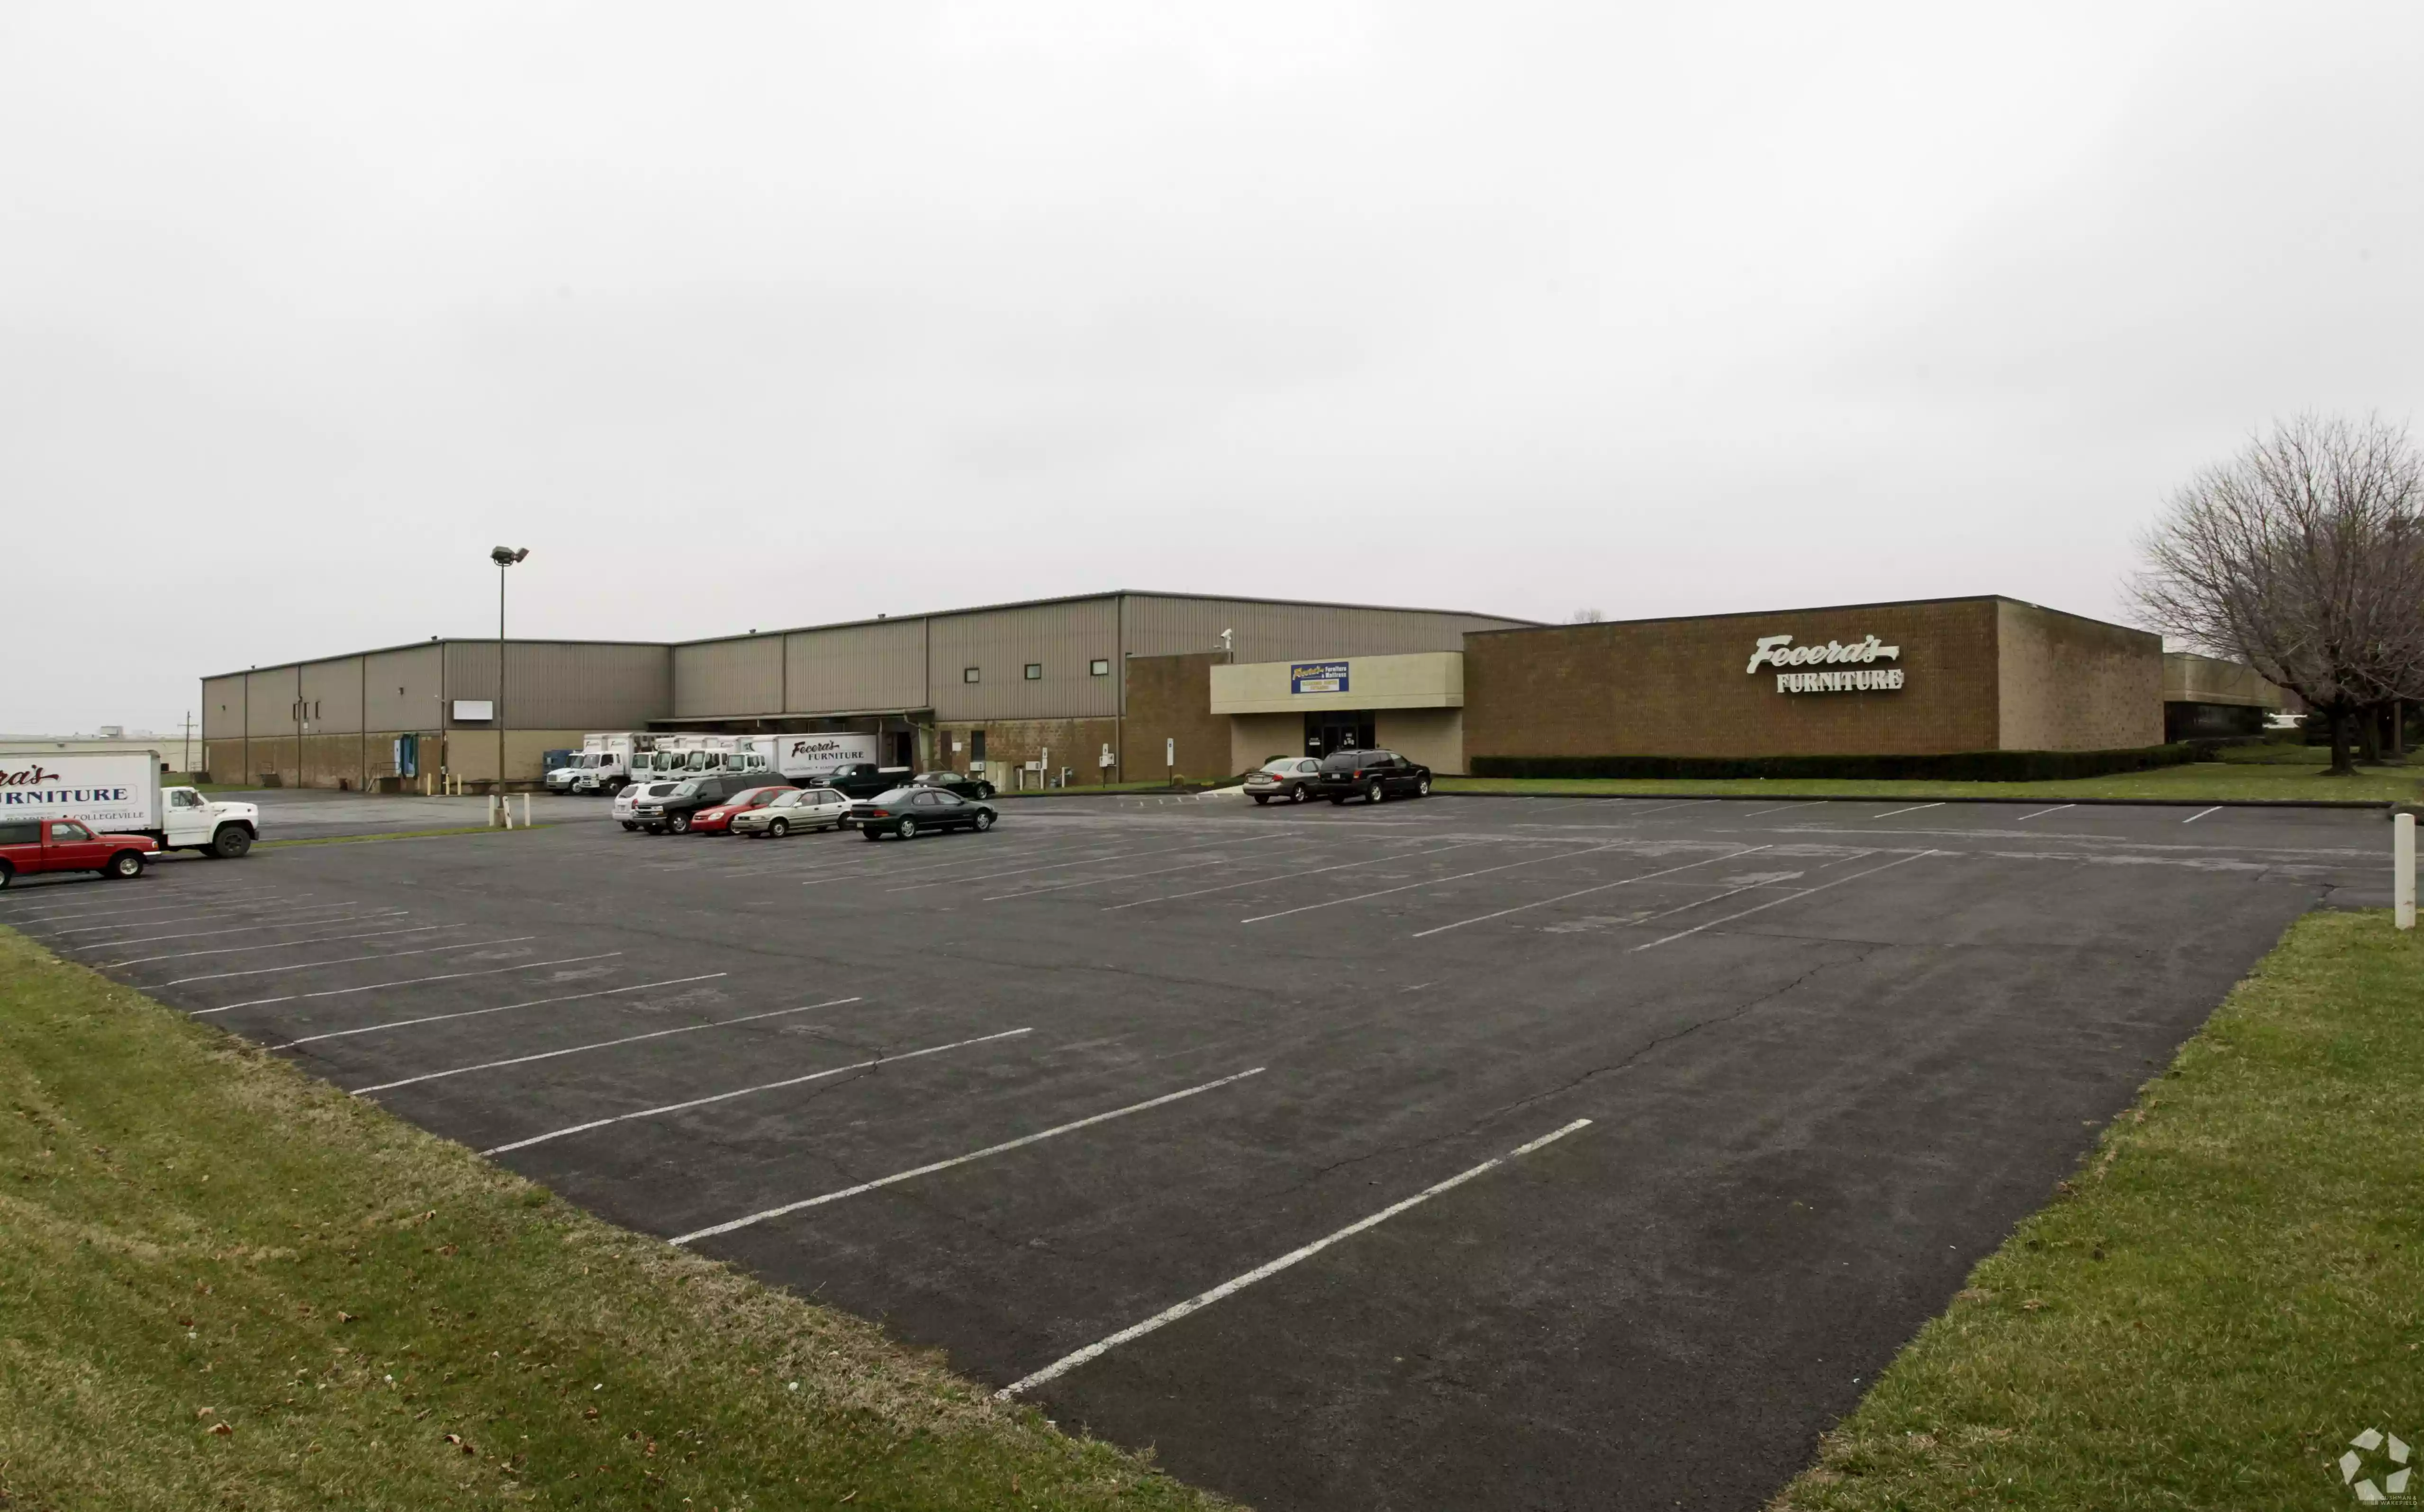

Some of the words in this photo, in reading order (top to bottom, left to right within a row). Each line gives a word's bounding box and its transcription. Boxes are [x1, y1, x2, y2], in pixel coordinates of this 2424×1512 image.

[1746, 634, 1899, 674] Fecera's
[1777, 669, 1903, 693] FURNITURE
[791, 740, 840, 757] Fecera's
[808, 751, 864, 761] FURNITURE
[0, 788, 128, 805] RNITURE
[74, 812, 145, 821] COLLEGEVILLE
